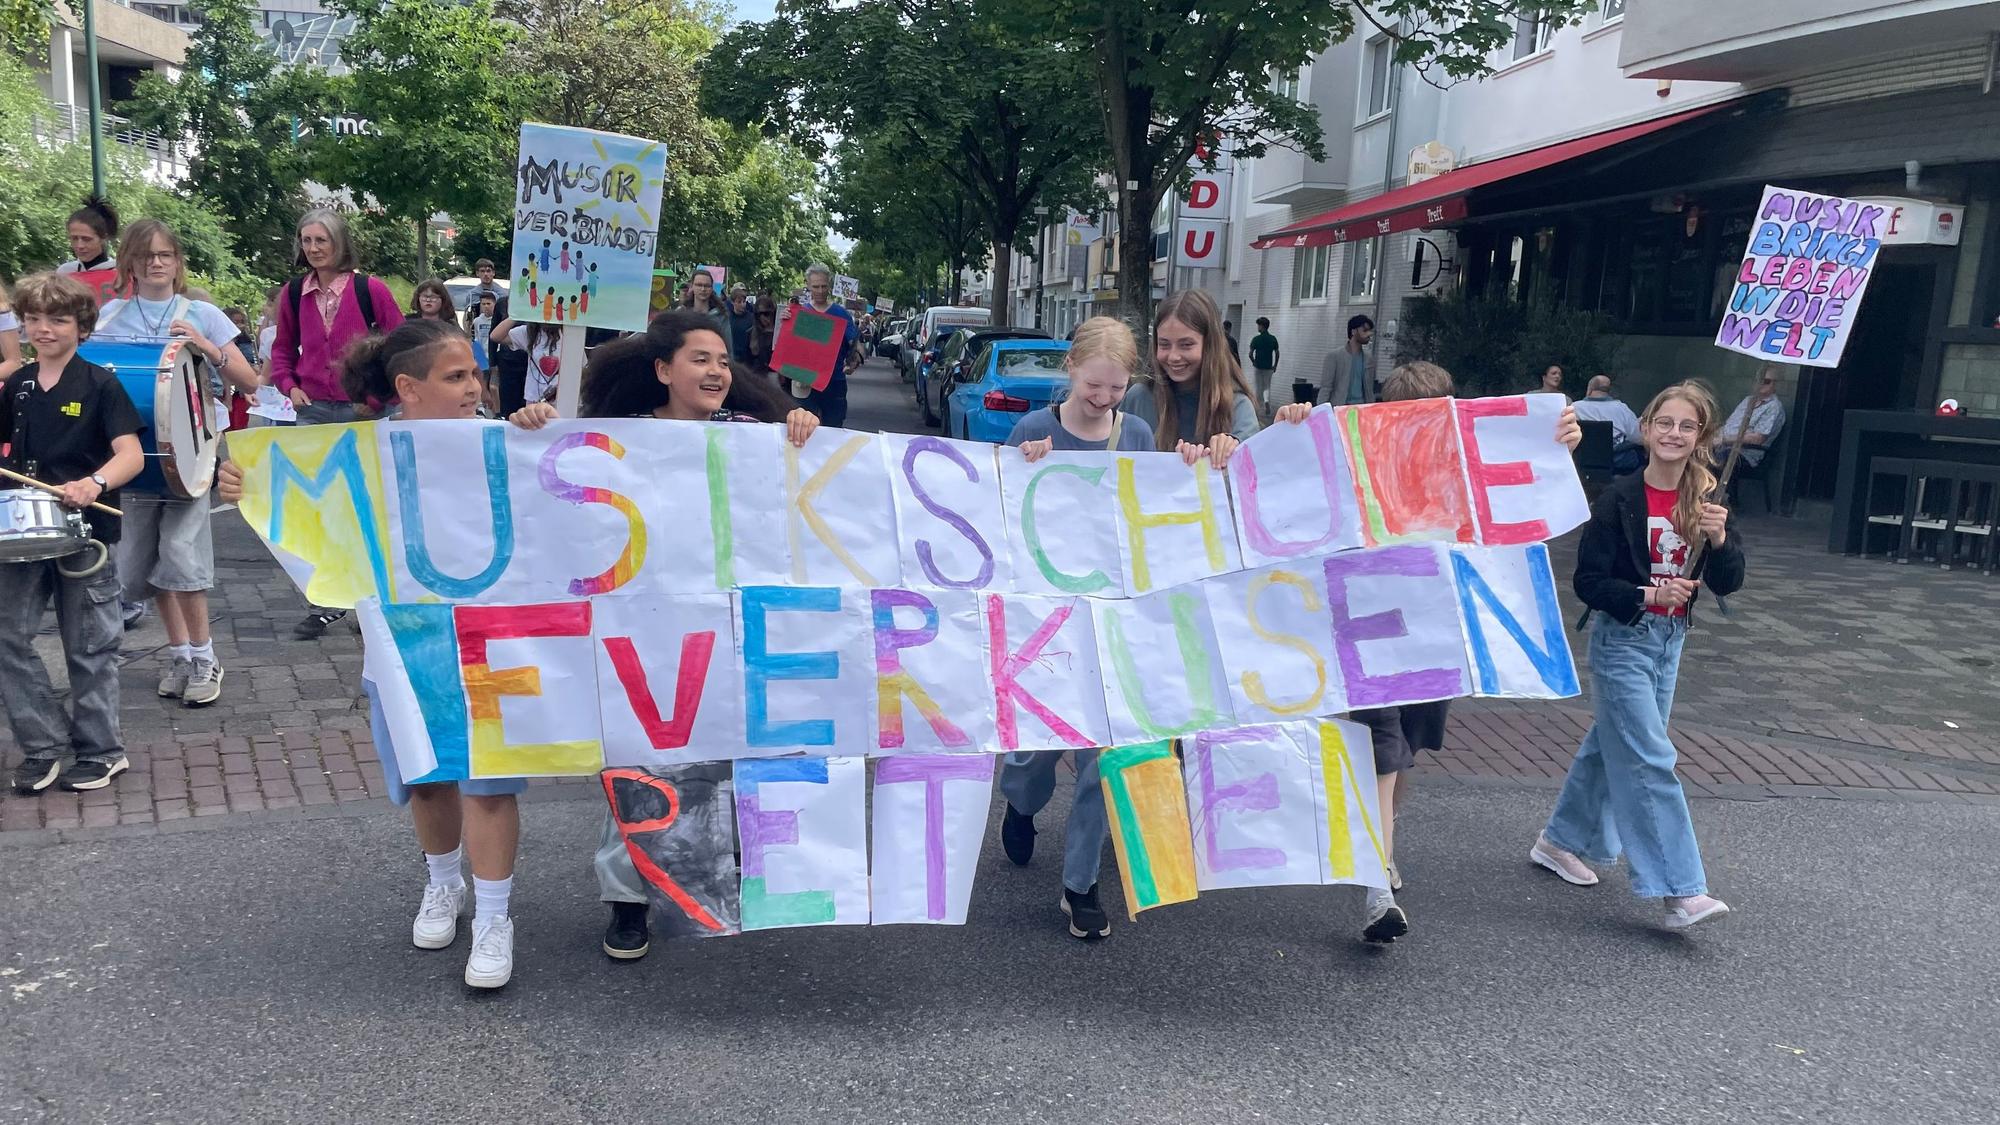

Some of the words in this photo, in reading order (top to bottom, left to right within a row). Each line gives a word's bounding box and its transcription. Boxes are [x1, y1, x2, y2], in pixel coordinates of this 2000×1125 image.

[520, 155, 637, 204] MUSIK
[517, 207, 658, 257] VERBINDET
[1761, 193, 1883, 238] MUSIK
[1750, 222, 1881, 268] BRINGT
[1738, 256, 1868, 300] LEBEN
[1731, 284, 1779, 315] IN
[1775, 290, 1846, 328] DIE
[1720, 314, 1835, 359] WELT
[269, 397, 1553, 603] MUSIKSCHULE
[388, 543, 1582, 780] EVERKUSEN
